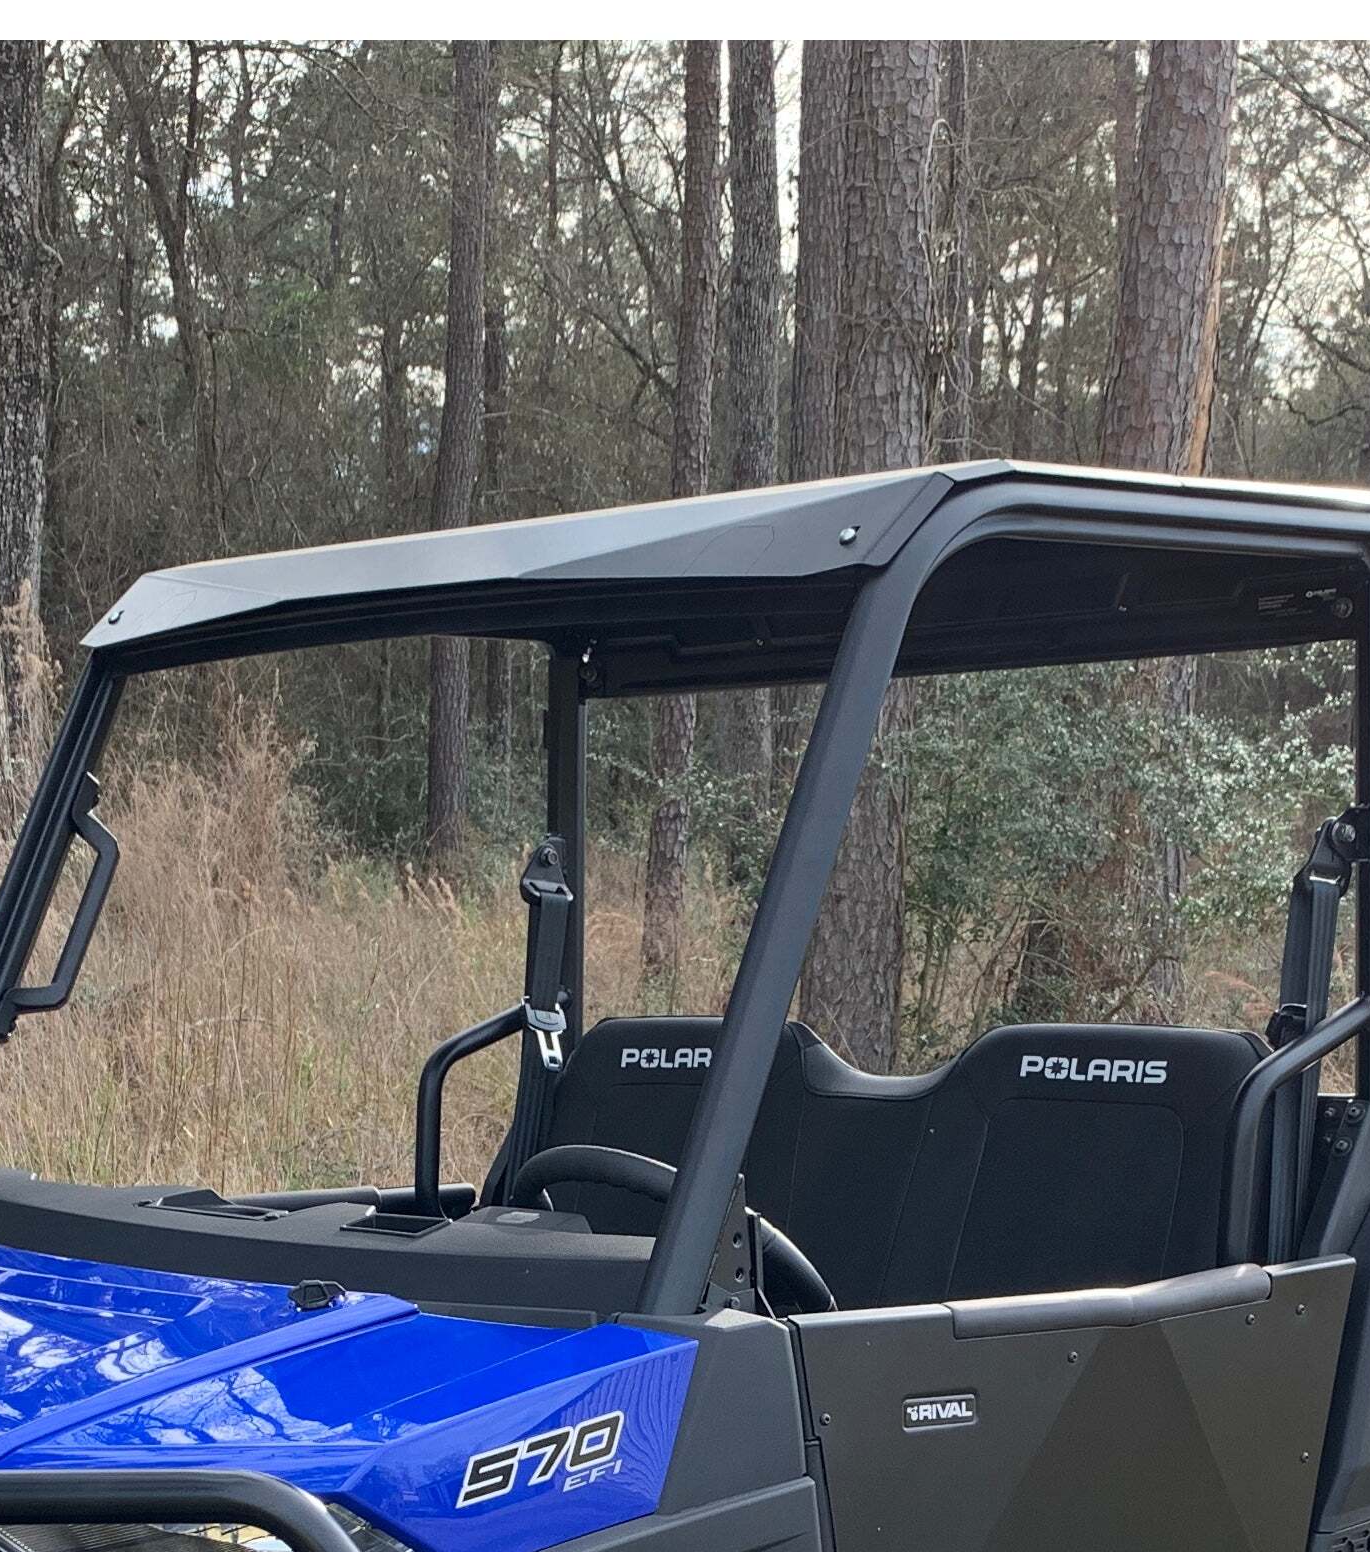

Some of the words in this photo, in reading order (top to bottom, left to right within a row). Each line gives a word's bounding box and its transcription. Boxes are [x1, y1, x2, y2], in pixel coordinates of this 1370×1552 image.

[620, 1047, 713, 1069] POLAR
[1019, 1054, 1169, 1085] POLARIS
[918, 1400, 974, 1421] RIVAL
[454, 1410, 625, 1510] 570
[562, 1458, 623, 1493] EFI
